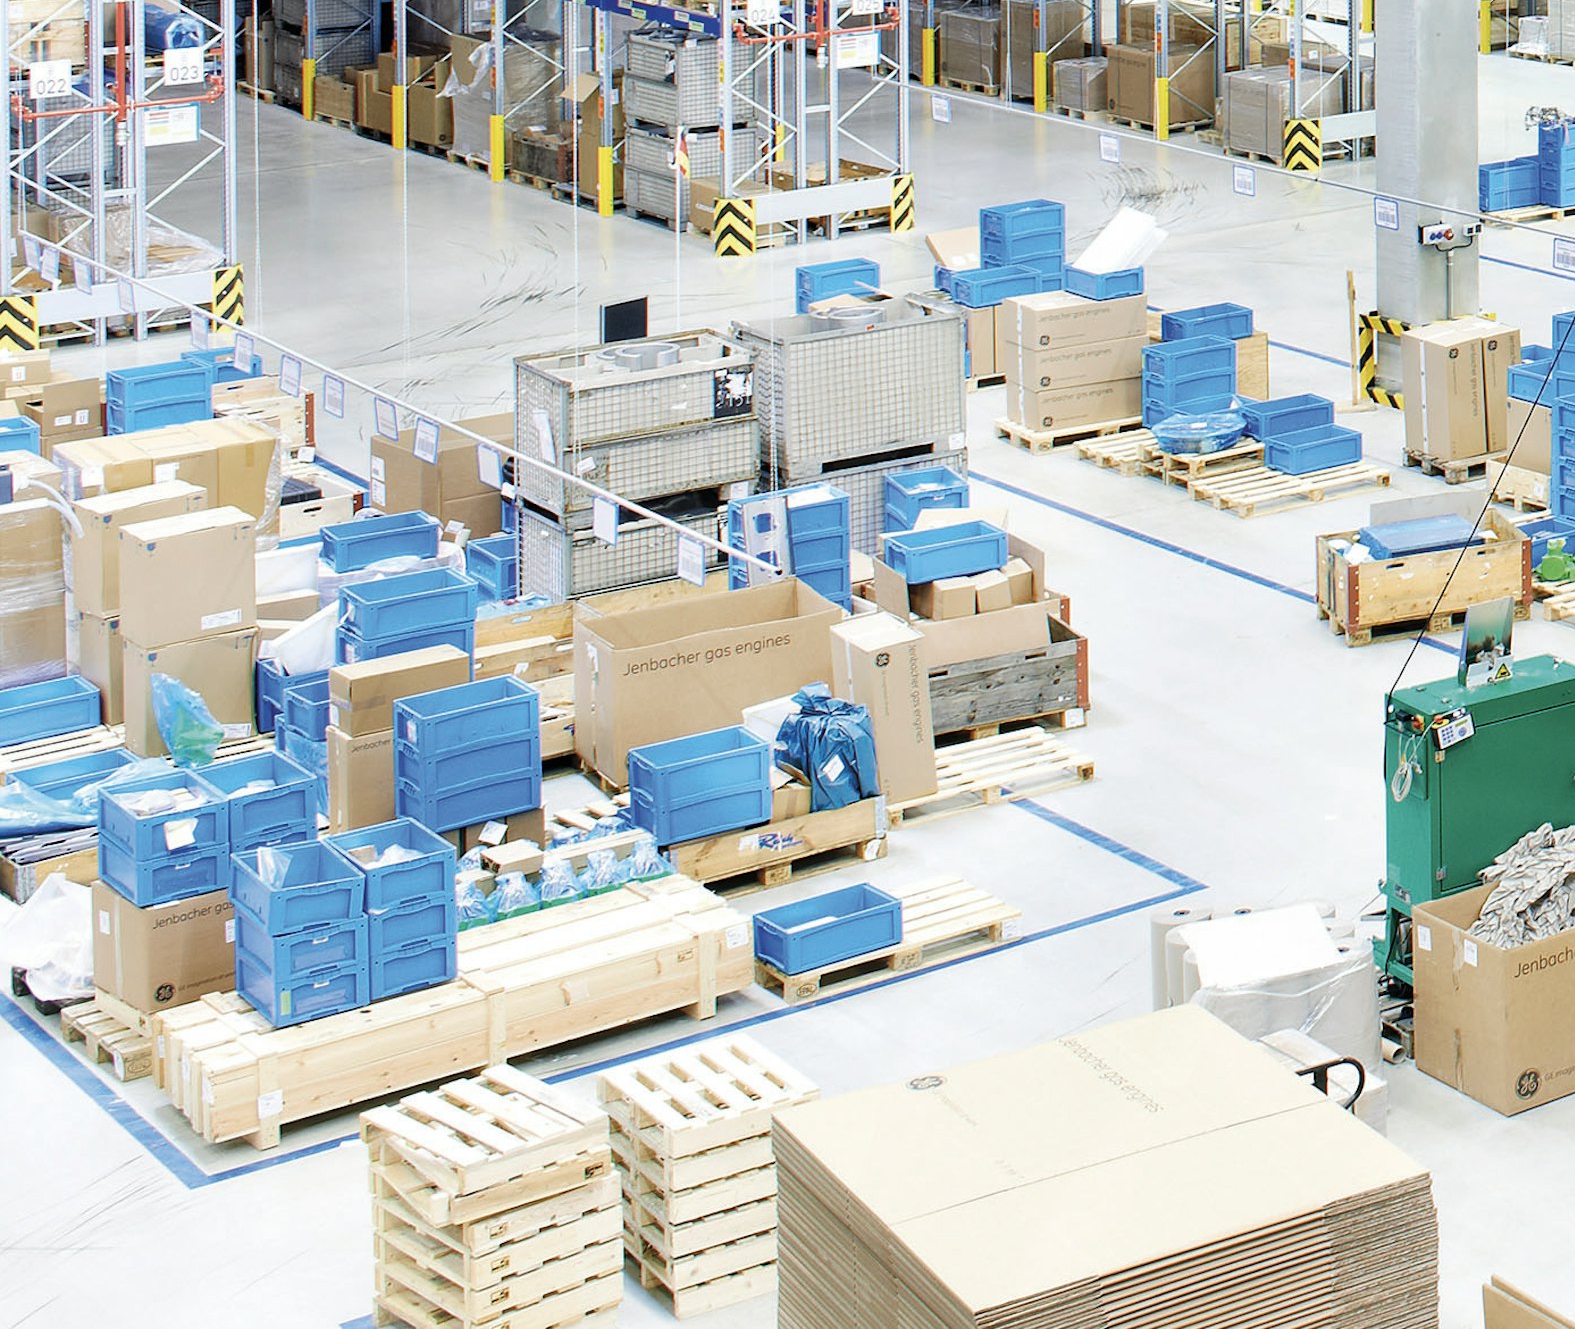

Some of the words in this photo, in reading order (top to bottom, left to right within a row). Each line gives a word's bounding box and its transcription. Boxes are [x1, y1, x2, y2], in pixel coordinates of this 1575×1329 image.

[170, 65, 200, 82] 023
[36, 78, 67, 95] 022
[622, 649, 701, 677] Jenbacher
[704, 645, 731, 664] gas
[735, 632, 792, 654] engines
[152, 905, 212, 929] Jenbacher
[214, 902, 235, 915] gas
